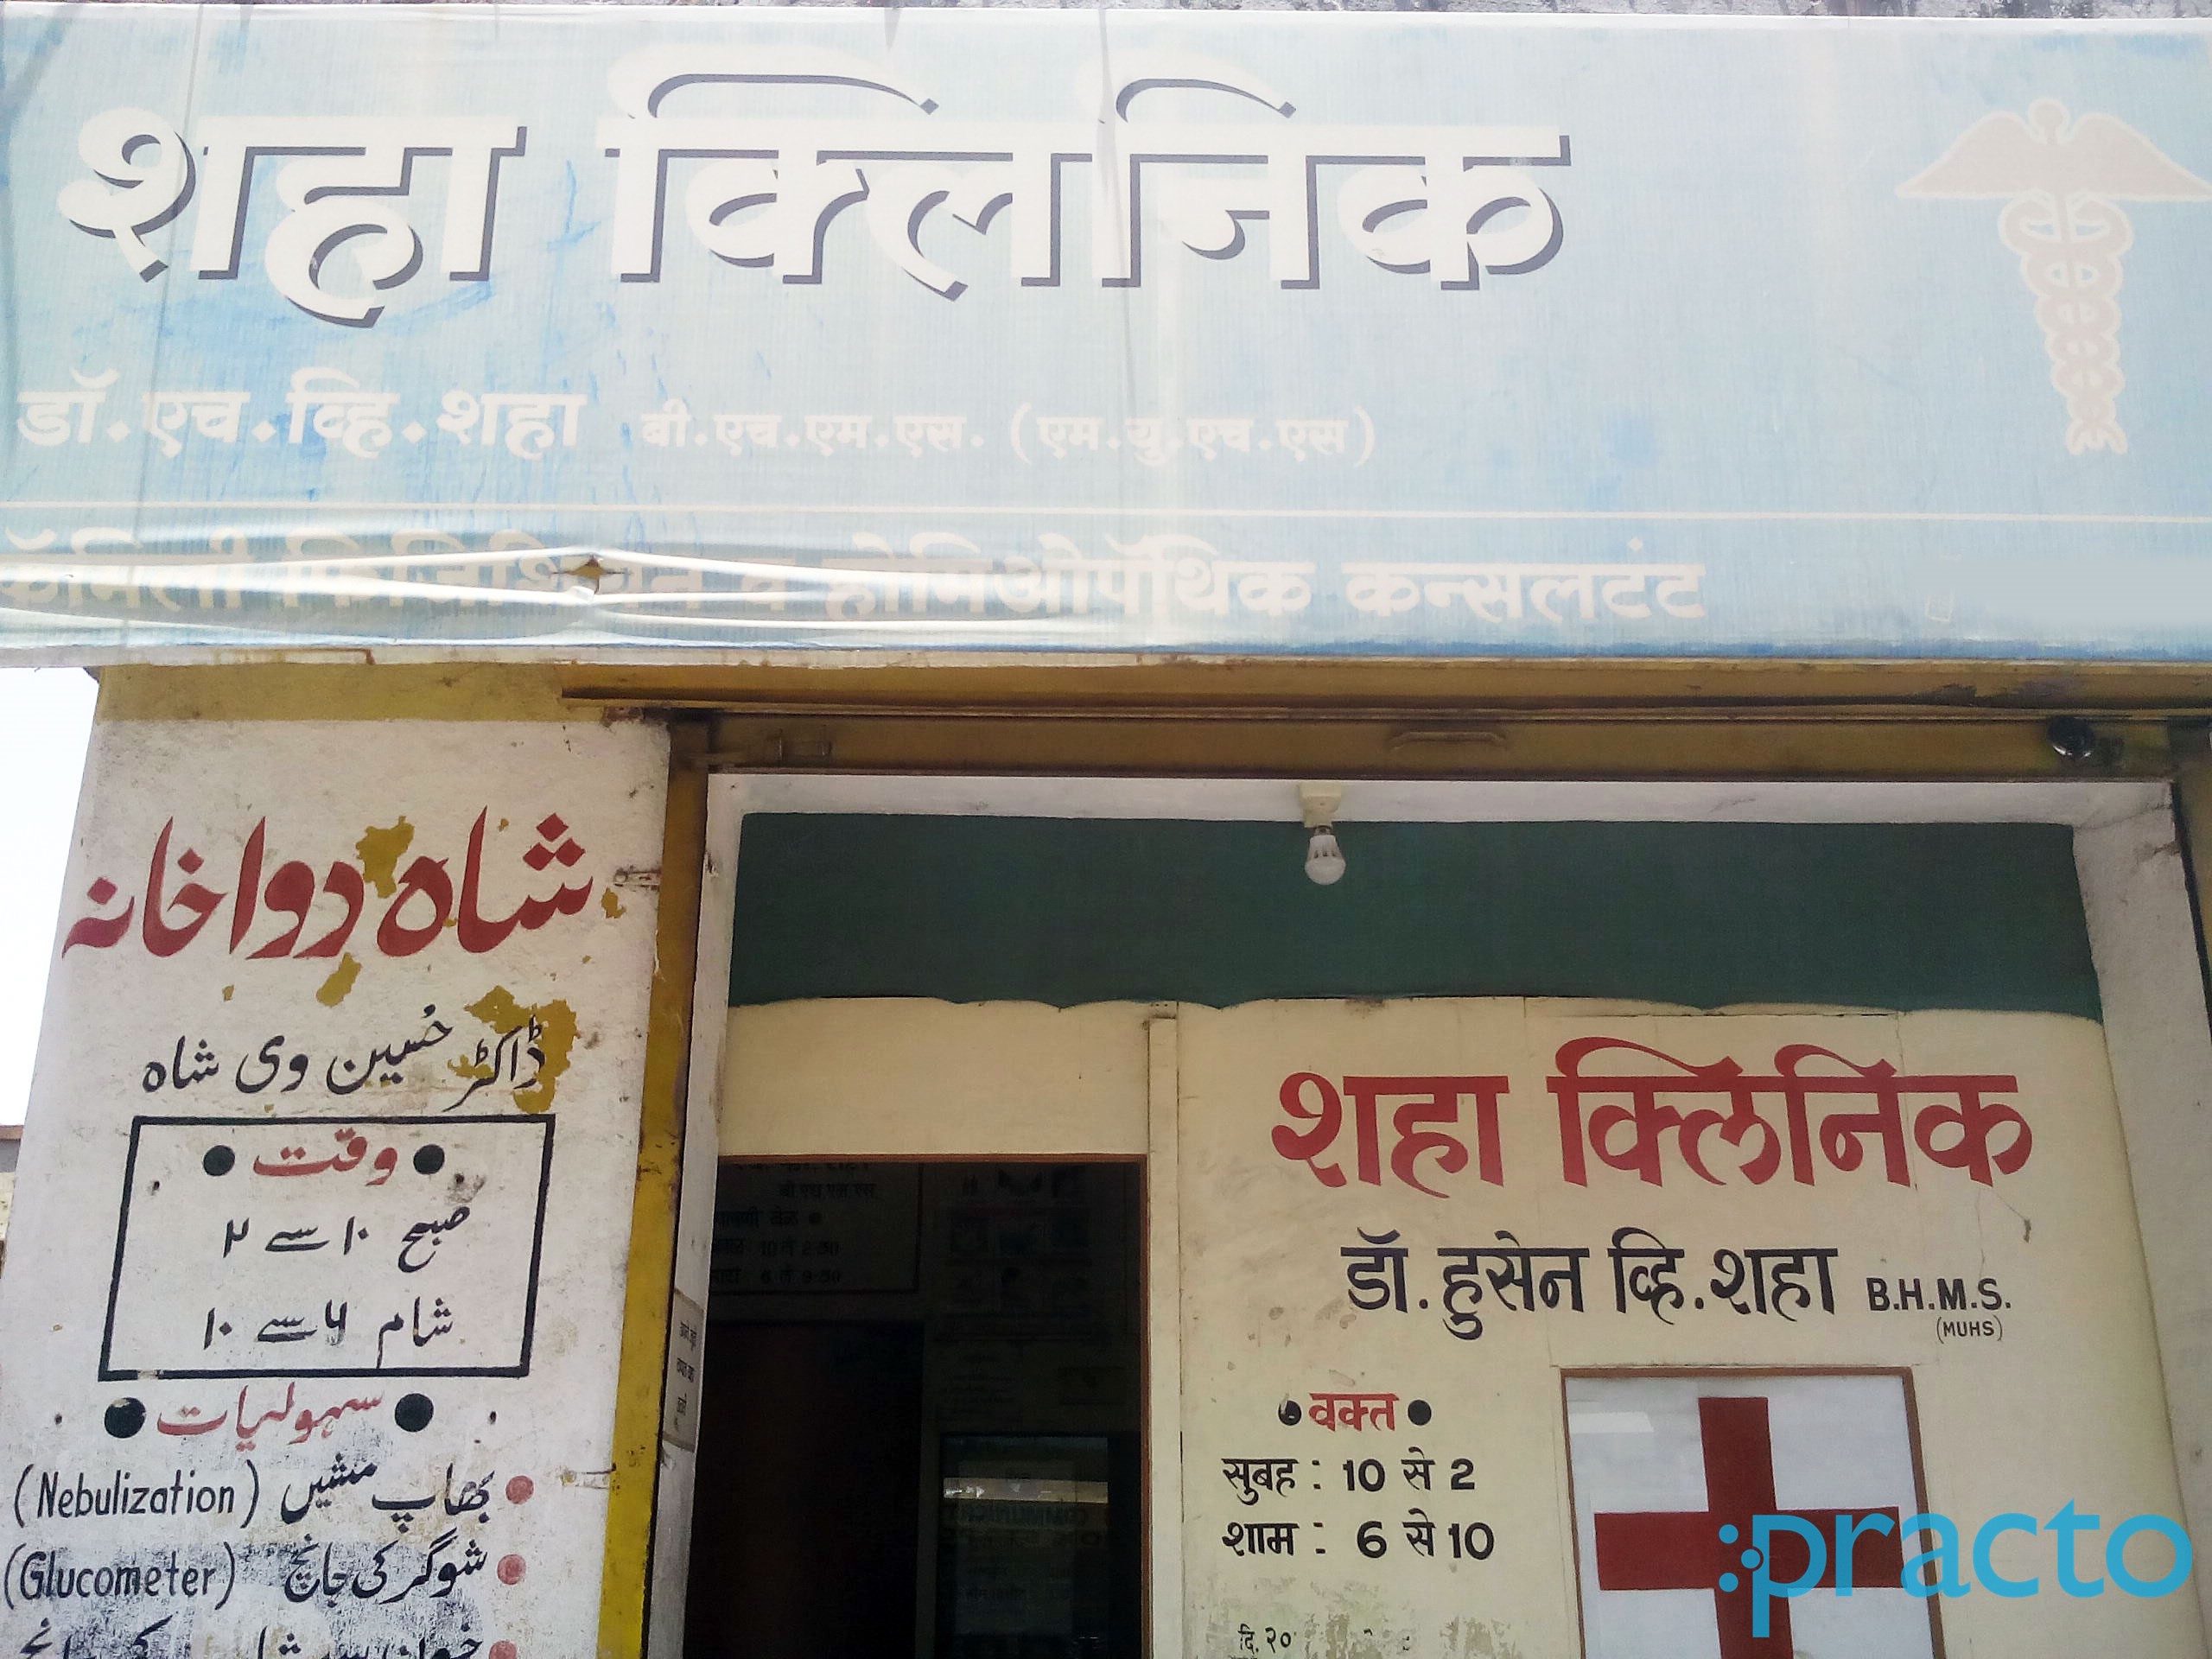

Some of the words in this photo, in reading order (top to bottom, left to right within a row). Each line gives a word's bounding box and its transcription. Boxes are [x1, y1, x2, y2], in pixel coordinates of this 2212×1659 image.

[58, 105, 527, 328] शहा
[595, 40, 1571, 301] क्लिनिक
[1340, 537, 1707, 623] कन्सलटंट
[143, 1035, 219, 1092] شاہ
[1272, 1071, 1510, 1197] शहा
[1546, 1036, 2032, 1187] क्लिनिक
[254, 1128, 398, 1186] وقت
[398, 1206, 470, 1273] صبح
[1866, 1277, 2012, 1312] B.H.M.S.
[376, 1296, 453, 1368] شام
[1936, 1314, 2004, 1344] (MUHS)
[1309, 1393, 1400, 1431] वक्त
[1221, 1458, 1299, 1505] सुबह
[1343, 1459, 1386, 1492] 10
[1401, 1446, 1436, 1491] से
[1451, 1458, 1476, 1491] 2
[1222, 1522, 1300, 1557] शाम
[1357, 1521, 1387, 1559] 6
[1402, 1507, 1436, 1557] से
[1448, 1522, 1495, 1560] 10
